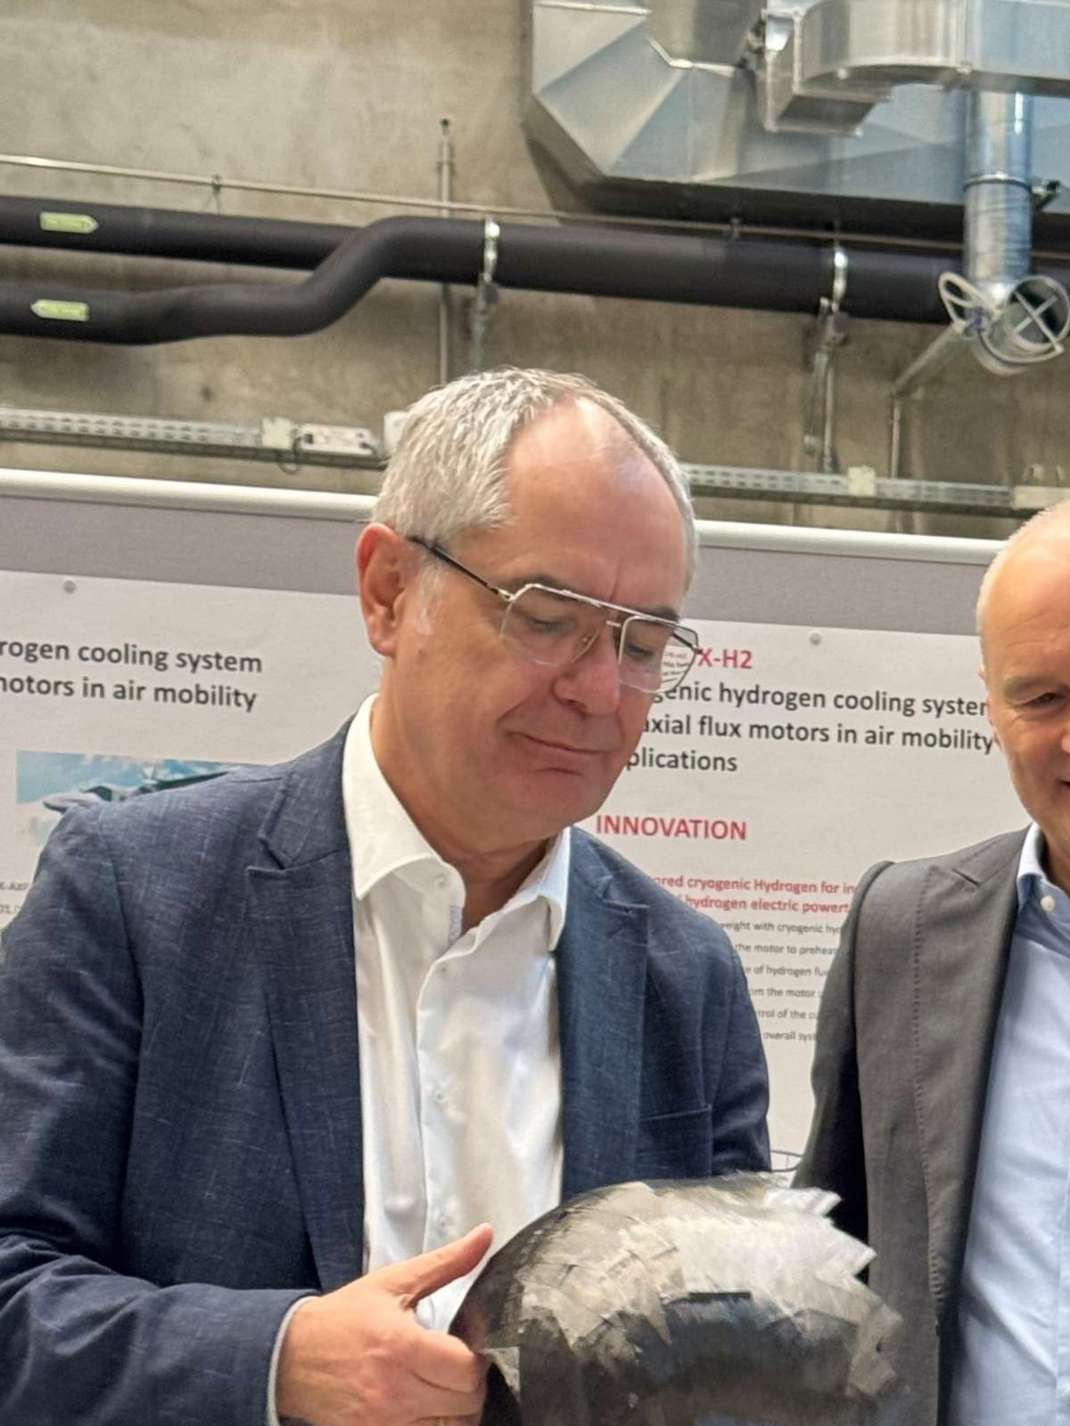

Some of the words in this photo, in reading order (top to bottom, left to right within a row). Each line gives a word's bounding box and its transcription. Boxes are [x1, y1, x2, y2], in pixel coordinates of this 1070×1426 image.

[0, 640, 70, 663] rogen
[78, 643, 169, 672] cooling
[175, 651, 262, 674] system
[82, 676, 105, 698] in
[112, 679, 147, 700] air
[154, 683, 258, 713] mobility
[719, 682, 826, 711] hydrogen
[833, 690, 915, 717] cooling
[697, 715, 741, 737] flux
[749, 722, 830, 742] motors
[837, 723, 857, 744] in
[864, 725, 895, 746] air
[901, 728, 993, 755] mobility
[595, 814, 748, 841] INNOVATION
[687, 876, 750, 892] cryogenic
[754, 878, 818, 894] Hydrogen
[821, 880, 840, 894] for
[751, 897, 799, 913] electric
